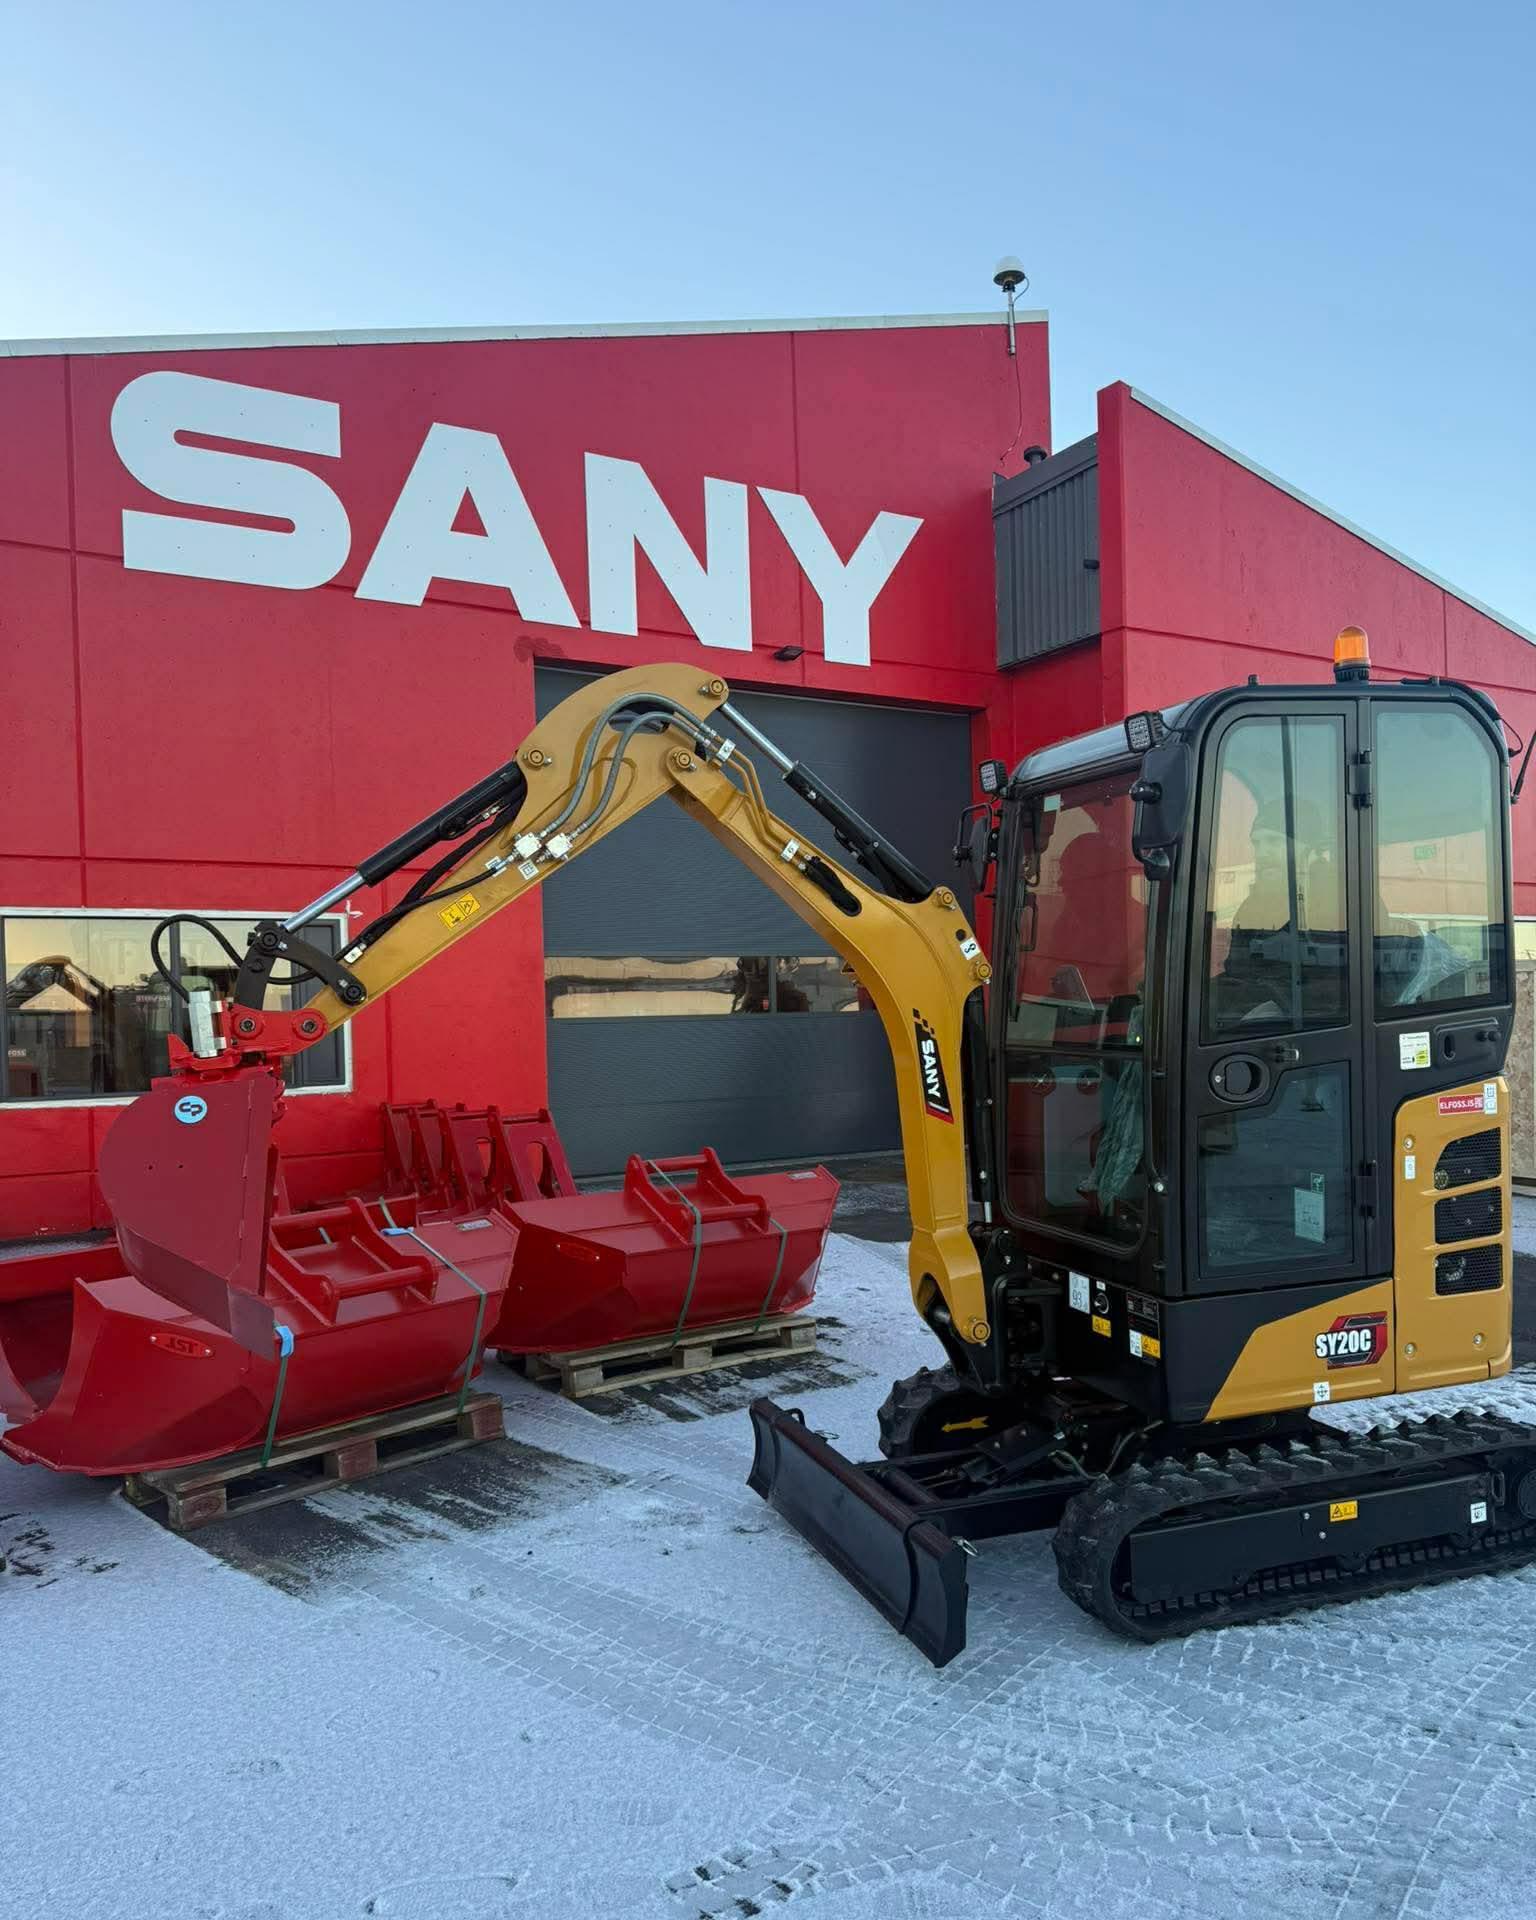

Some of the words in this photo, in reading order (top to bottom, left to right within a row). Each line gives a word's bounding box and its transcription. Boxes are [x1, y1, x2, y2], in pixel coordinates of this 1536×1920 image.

[110, 370, 923, 667] SANY
[921, 1039, 941, 1098] SANY
[1440, 1099, 1474, 1110] ELFOSS.IS
[1315, 1328, 1372, 1358] SY20C
